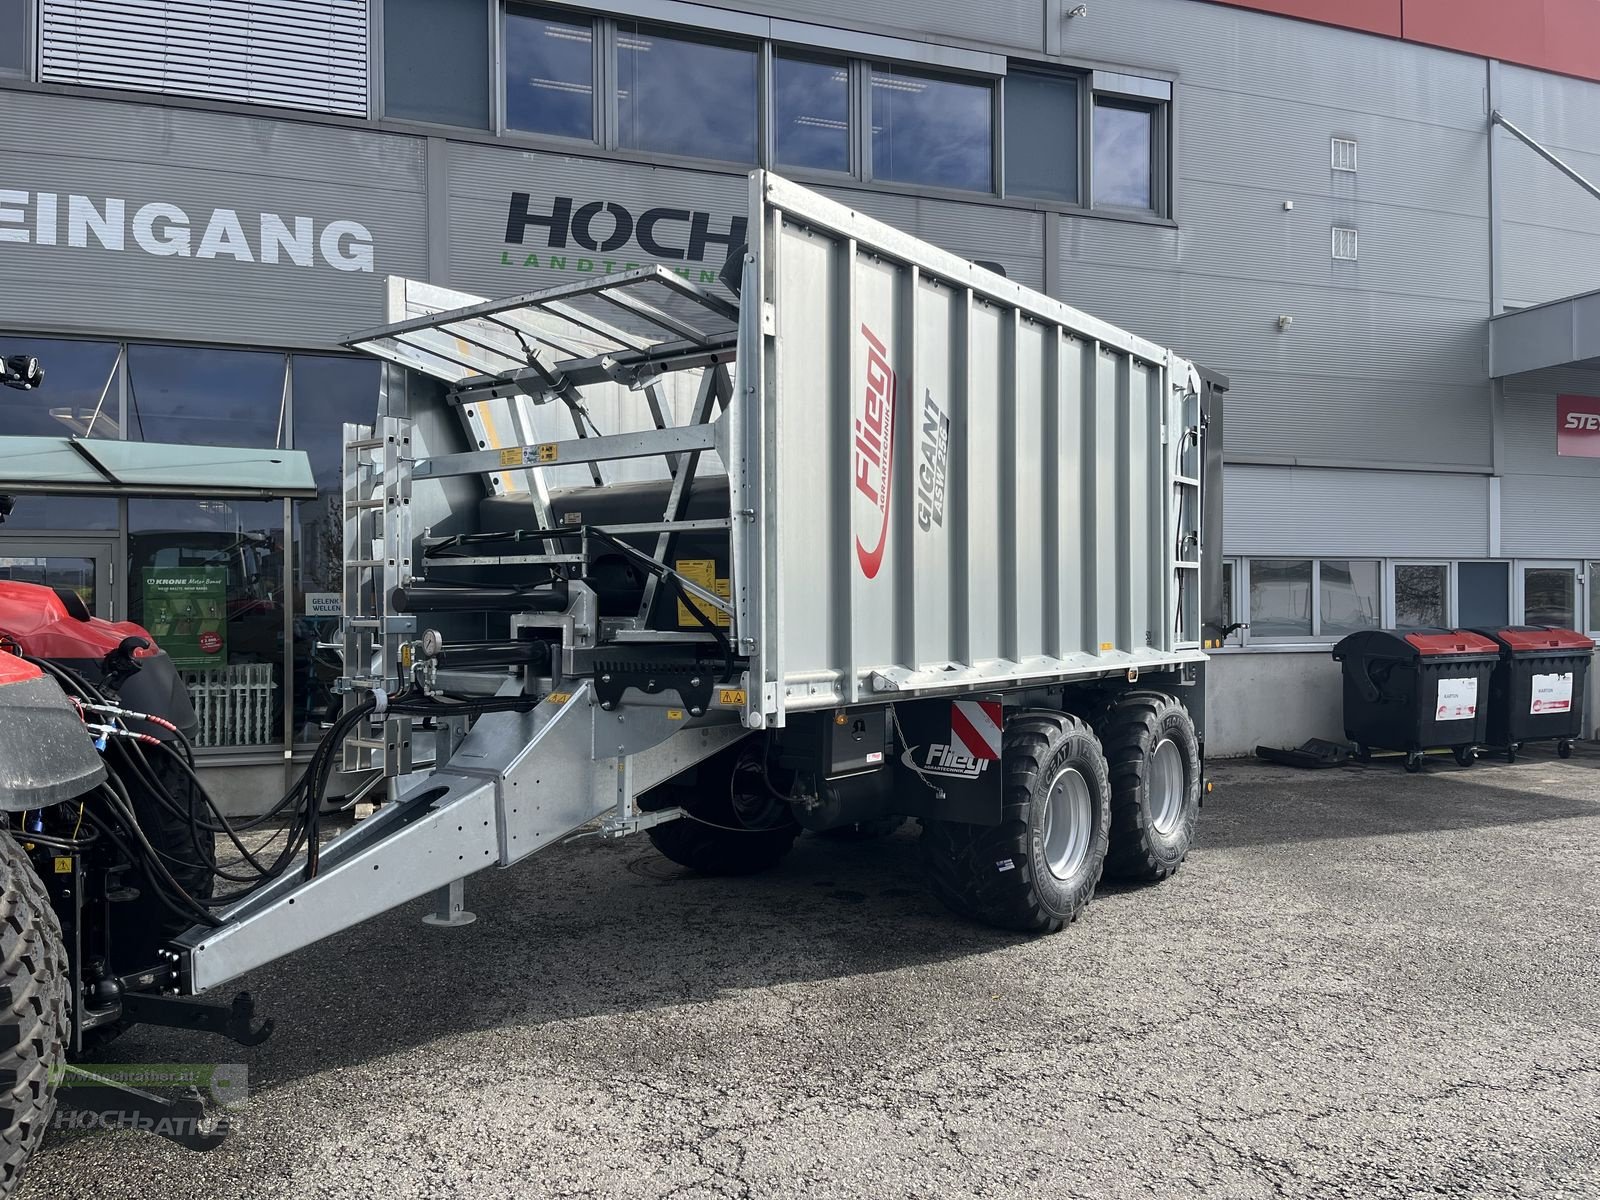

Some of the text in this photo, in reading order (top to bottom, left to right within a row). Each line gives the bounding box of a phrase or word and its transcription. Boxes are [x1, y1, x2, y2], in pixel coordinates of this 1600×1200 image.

[0, 189, 374, 273] EINGANG
[505, 192, 748, 262] HOCH
[856, 322, 892, 505] Fliegl
[1564, 412, 1600, 431] STE
[879, 407, 890, 513] AGRARTECHNIK
[918, 387, 939, 533] GIGANT
[933, 426, 949, 516] ASW 256
[924, 765, 965, 774] AGRARTECHNIK
